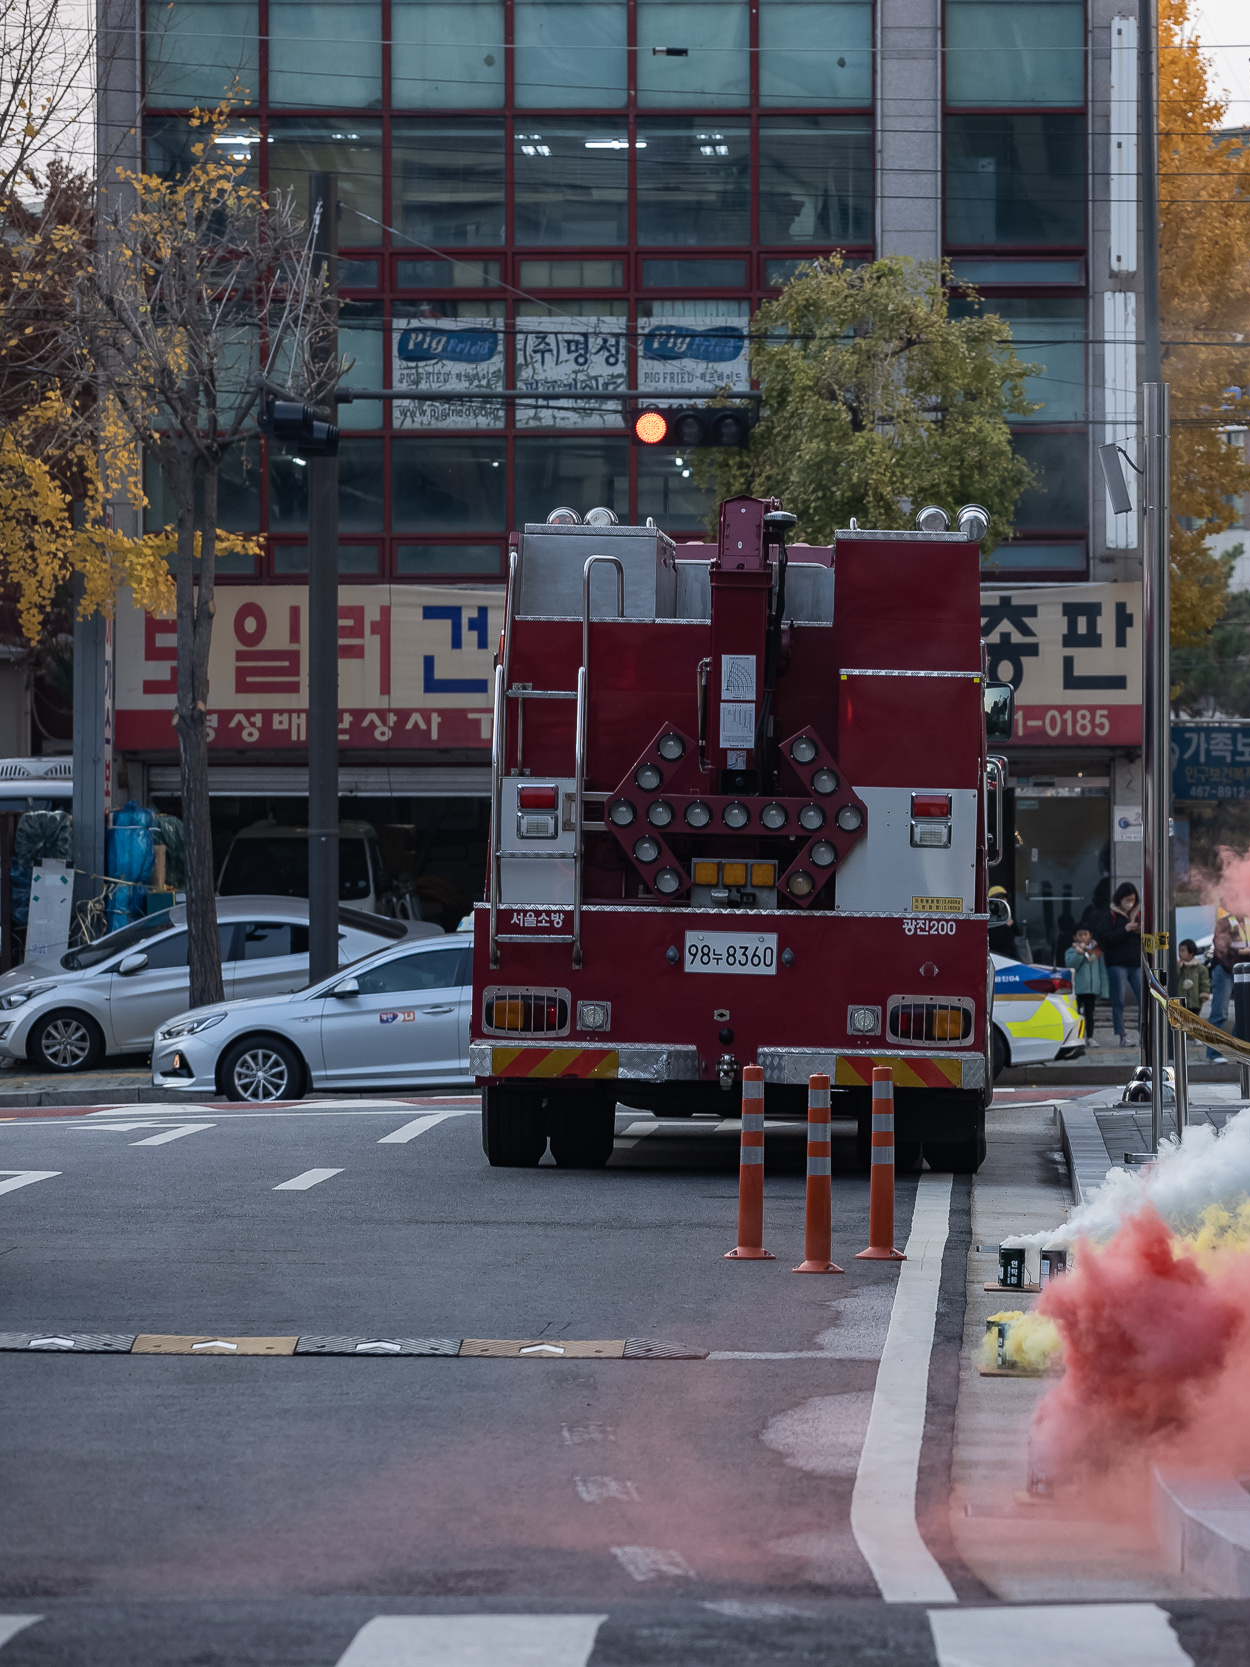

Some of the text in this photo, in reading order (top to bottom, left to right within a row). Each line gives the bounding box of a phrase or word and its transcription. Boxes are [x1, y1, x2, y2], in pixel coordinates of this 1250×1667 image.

[408, 332, 447, 354] Pig
[980, 596, 1134, 693] 총판
[206, 712, 442, 743] 성배상사
[510, 912, 565, 928] 서울소방
[902, 919, 957, 935] 광진200
[688, 944, 774, 968] 98누8360
